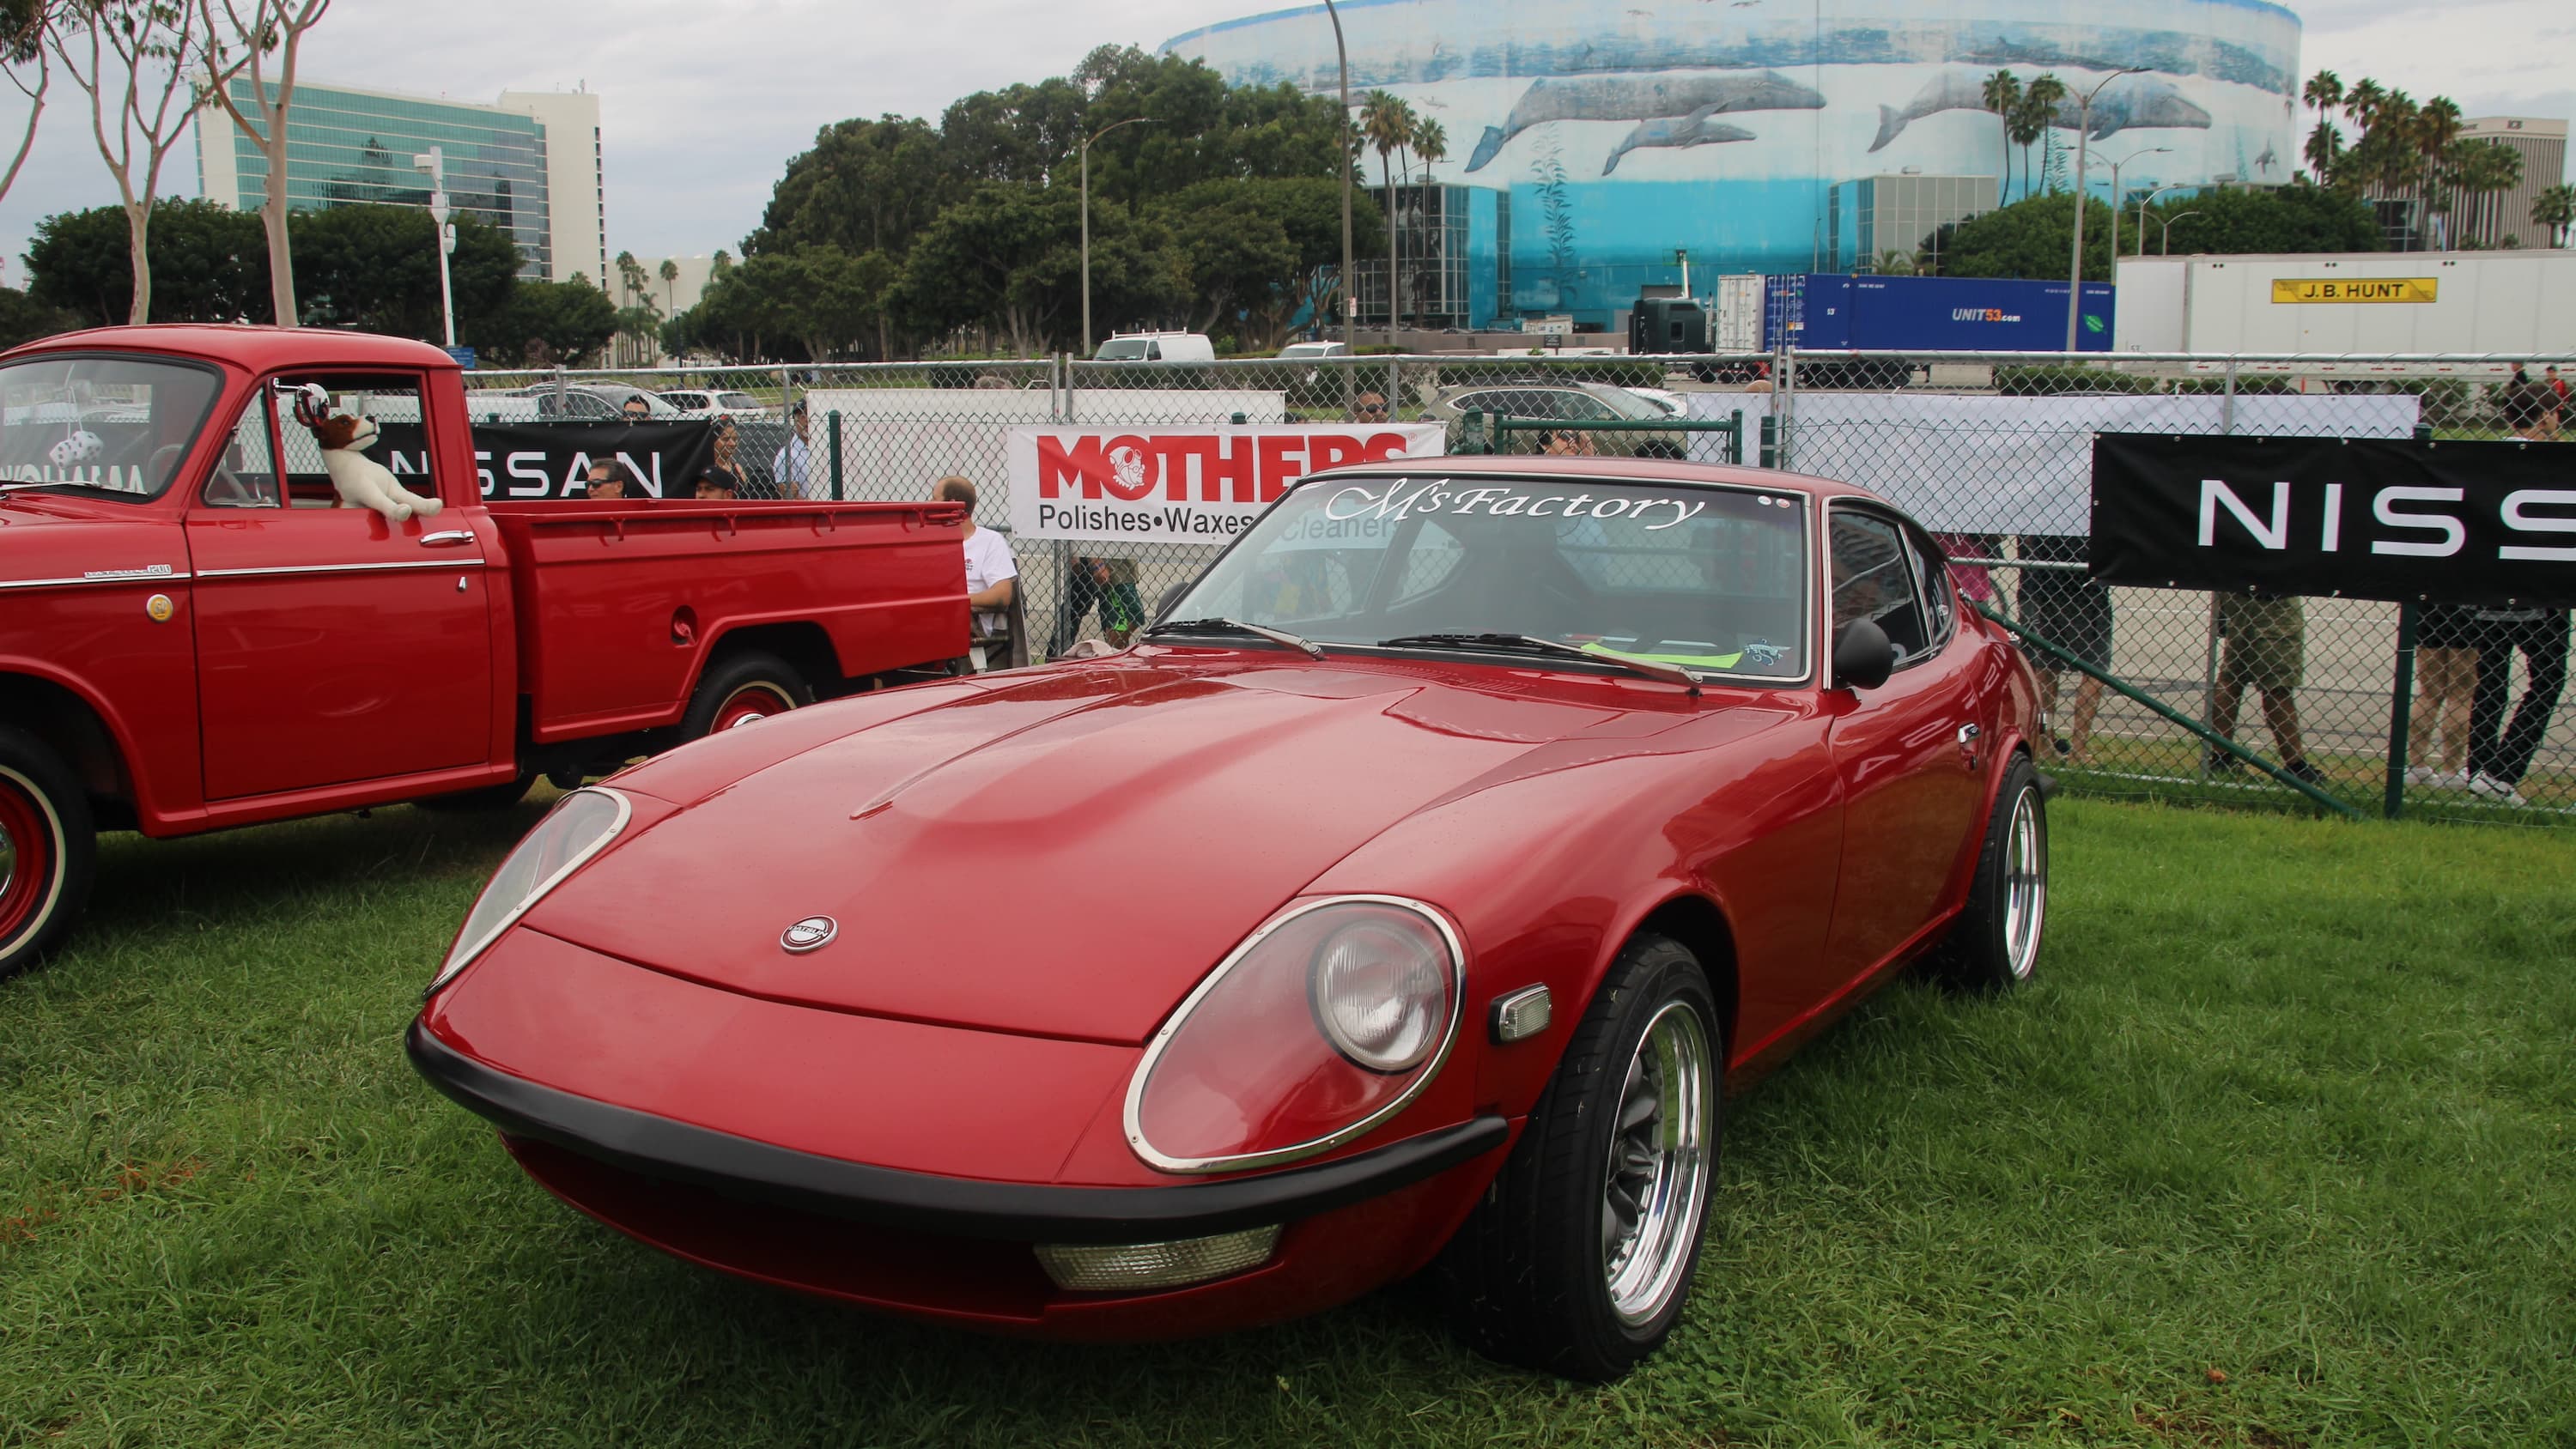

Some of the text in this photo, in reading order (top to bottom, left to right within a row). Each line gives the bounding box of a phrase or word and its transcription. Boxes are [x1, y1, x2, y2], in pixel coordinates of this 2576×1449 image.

[2346, 283, 2404, 298] HUNT
[1952, 308, 2020, 323] UNIT53.com
[391, 450, 662, 498] NSAN
[1450, 488, 1707, 530] Factory
[2197, 479, 2576, 561] NISS
